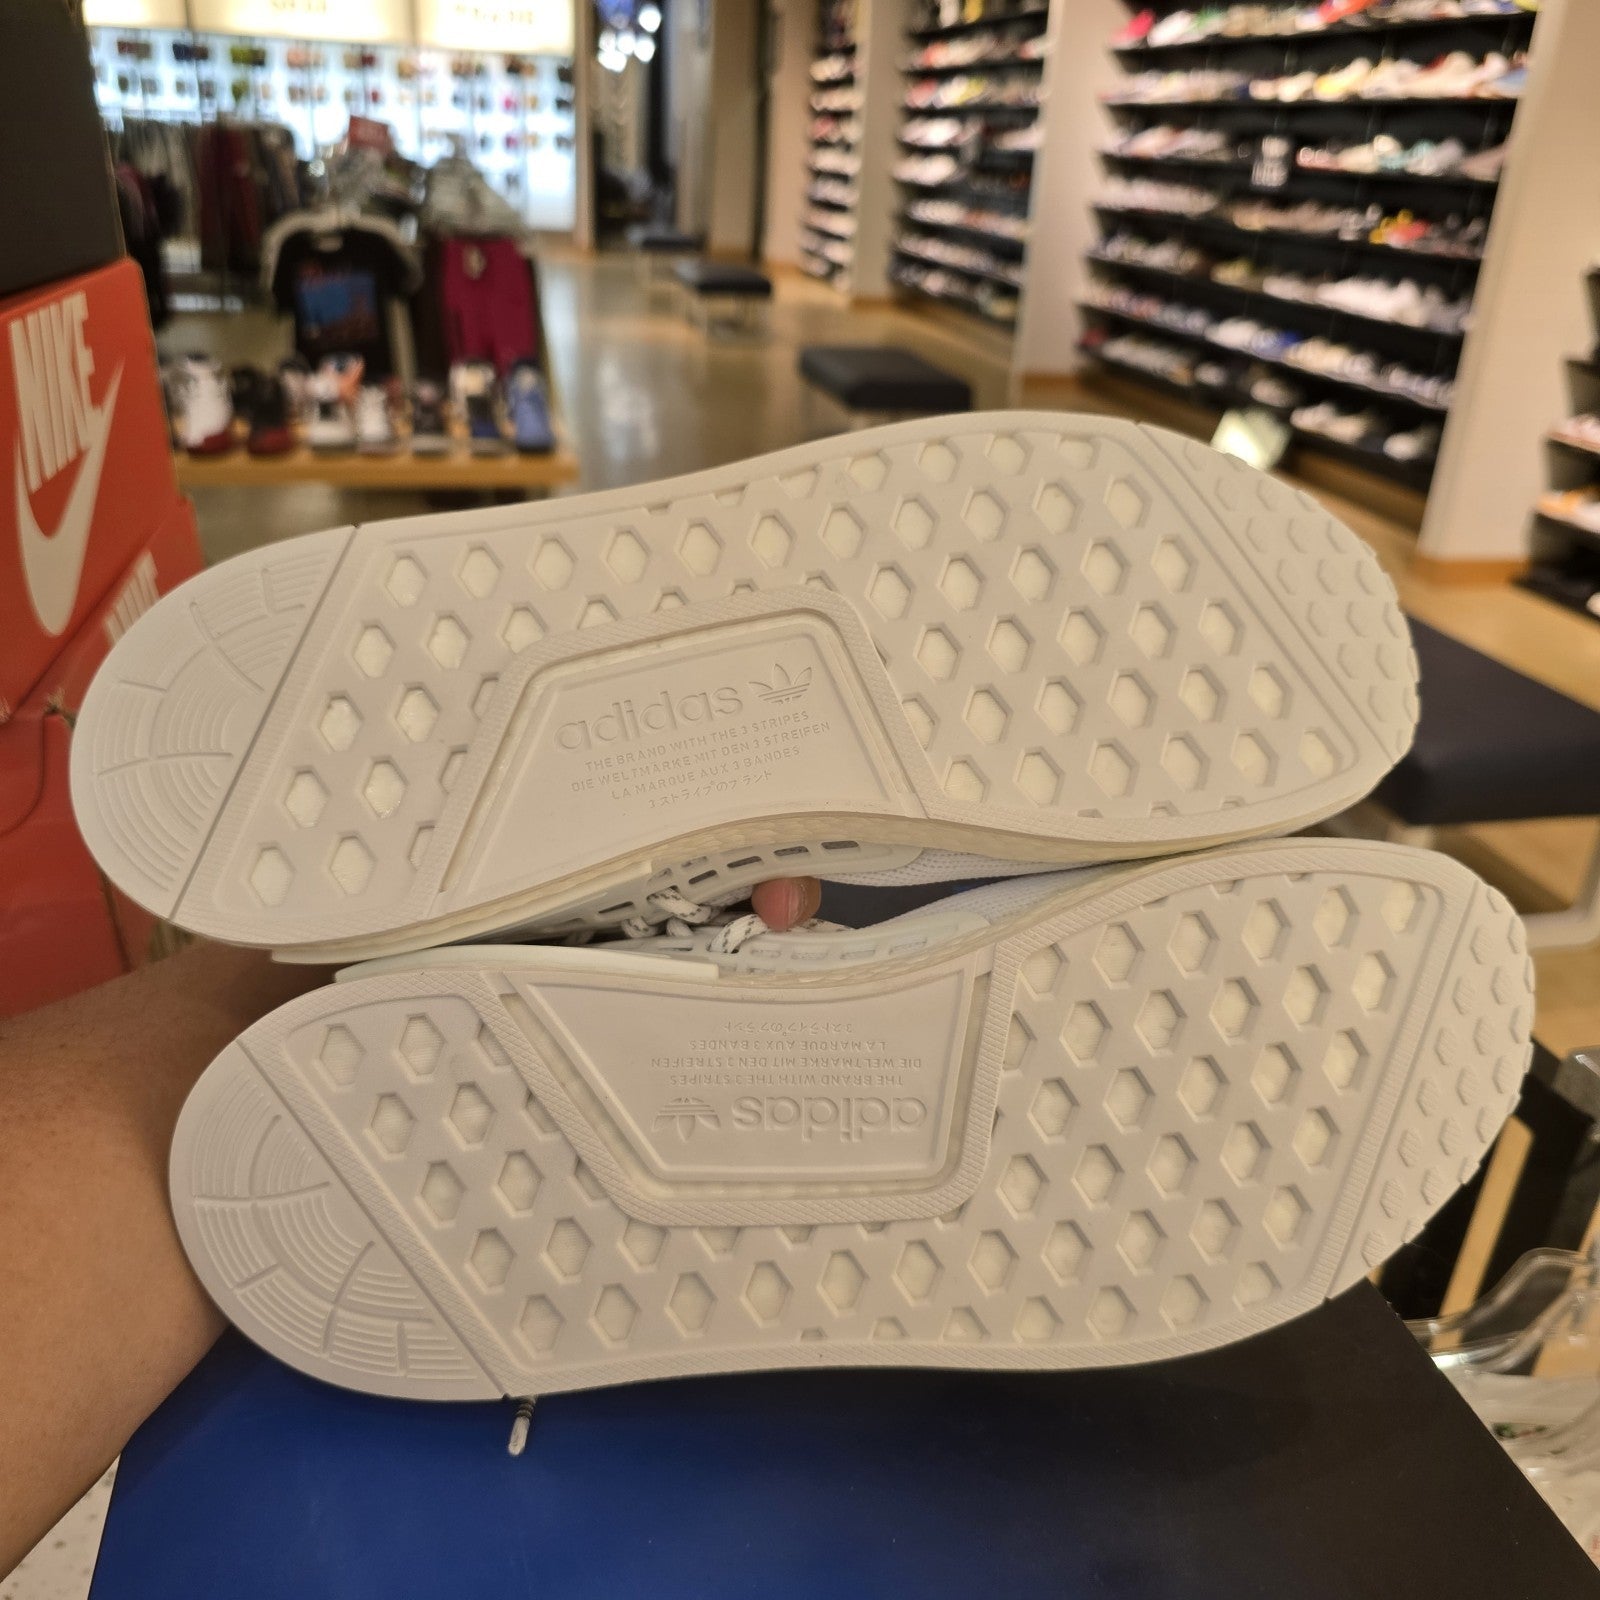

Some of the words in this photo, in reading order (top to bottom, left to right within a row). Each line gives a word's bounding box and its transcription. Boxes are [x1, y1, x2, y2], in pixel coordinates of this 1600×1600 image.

[9, 290, 104, 495] NIKE
[554, 686, 744, 751] adidas
[585, 758, 613, 773] THE
[616, 745, 667, 766] BRAND
[669, 735, 707, 752] WITH
[711, 727, 738, 743] THE
[741, 725, 749, 736] 3
[752, 710, 809, 733] STRIPES
[571, 777, 595, 793] DIE
[598, 756, 691, 786] WELTMARKE
[692, 749, 718, 764] MIT
[721, 741, 750, 757] DEN
[753, 739, 760, 750] 3
[764, 721, 831, 748] STREIFEN
[611, 787, 631, 801] LA
[635, 771, 695, 795] MARQUE
[700, 763, 729, 779] AUX
[732, 760, 739, 771] 3
[744, 747, 800, 768] BANDES
[689, 1039, 746, 1051] BANDES
[753, 1039, 760, 1051] 3
[765, 1039, 794, 1051] AUX
[800, 1039, 860, 1051] MARQUE
[866, 1039, 886, 1051] LA
[651, 1057, 722, 1069] STREIFEN
[727, 1057, 734, 1069] 3
[738, 1057, 767, 1069] DEN
[774, 1057, 795, 1069] MIT
[801, 1057, 895, 1069] WELTMARKE
[899, 1057, 921, 1069] DIE
[669, 1073, 731, 1086] STRIPES
[735, 1073, 743, 1086] 3
[749, 1073, 776, 1086] THE
[778, 1073, 817, 1086] WITH
[821, 1073, 873, 1086] BRAND
[878, 1073, 903, 1086] THE
[731, 1096, 927, 1143] adidas
